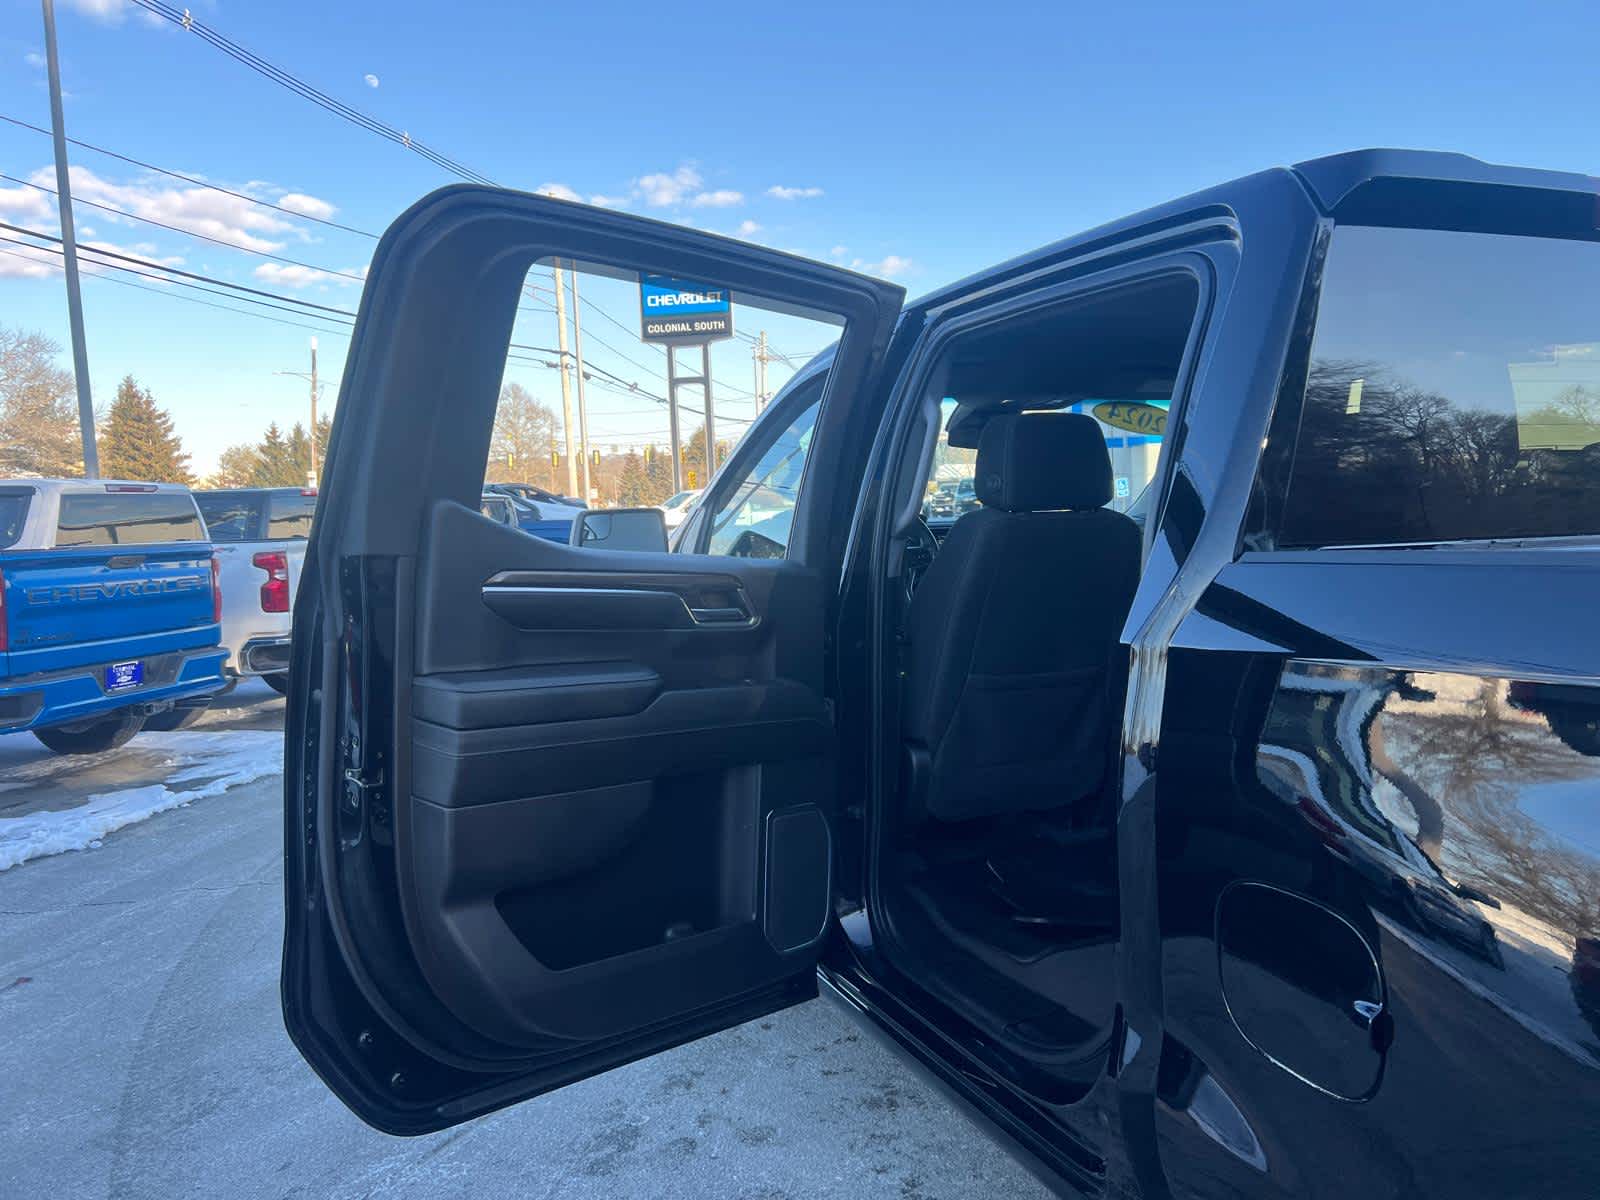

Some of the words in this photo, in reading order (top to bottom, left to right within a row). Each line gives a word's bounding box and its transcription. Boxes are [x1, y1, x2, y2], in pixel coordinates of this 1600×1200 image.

[647, 291, 722, 307] CHEVROLET
[647, 323, 692, 333] COLONIAL
[694, 320, 725, 331] SOUTH
[27, 575, 208, 604] CHEVROLET
